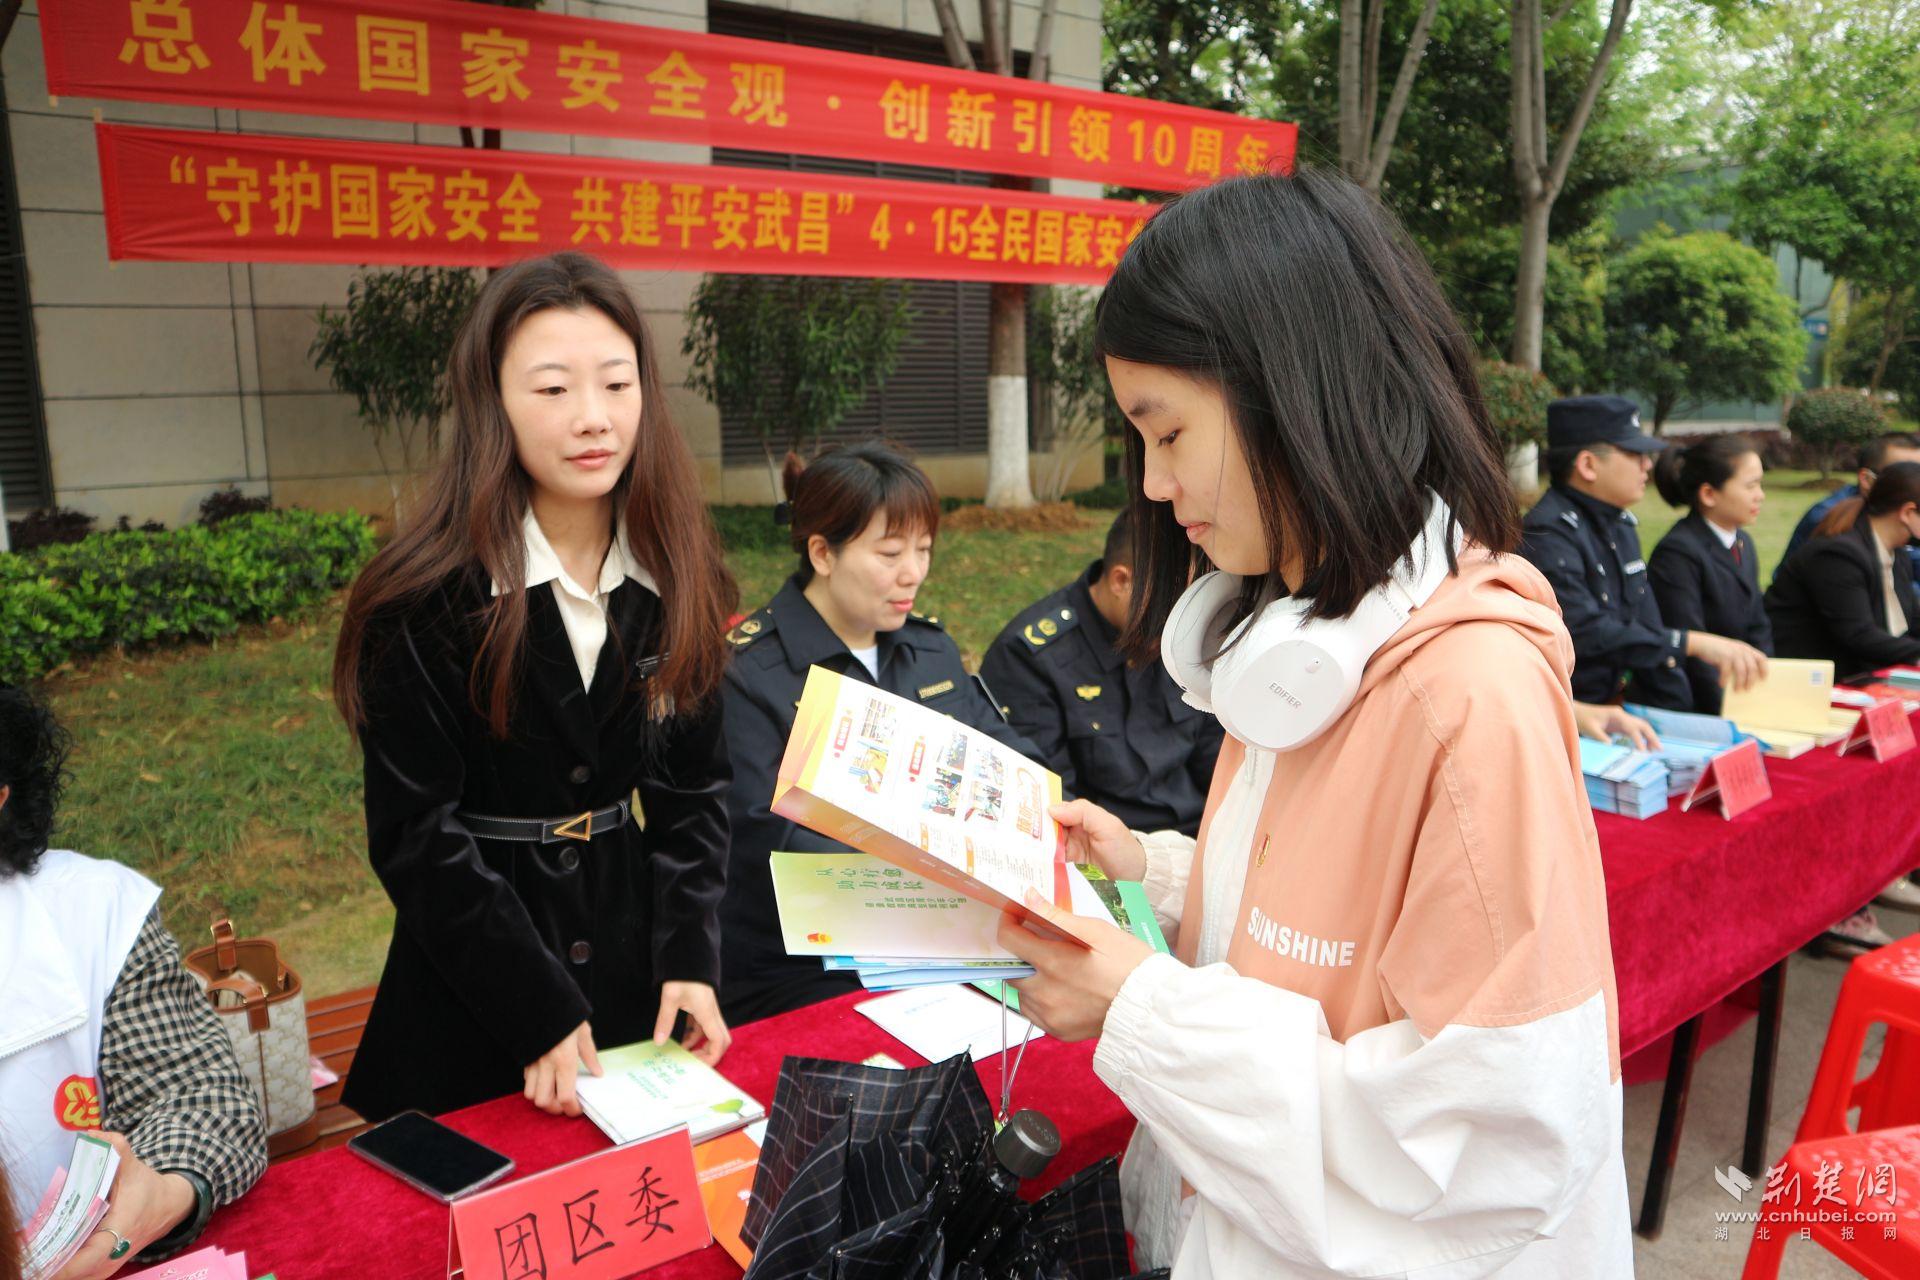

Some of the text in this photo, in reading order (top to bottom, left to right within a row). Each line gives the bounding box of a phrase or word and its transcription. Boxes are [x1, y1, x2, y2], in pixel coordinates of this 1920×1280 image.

[1268, 681, 1302, 709] EDIFIER
[1247, 906, 1356, 968] SUNSHINE
[494, 1166, 679, 1280] 团区委
